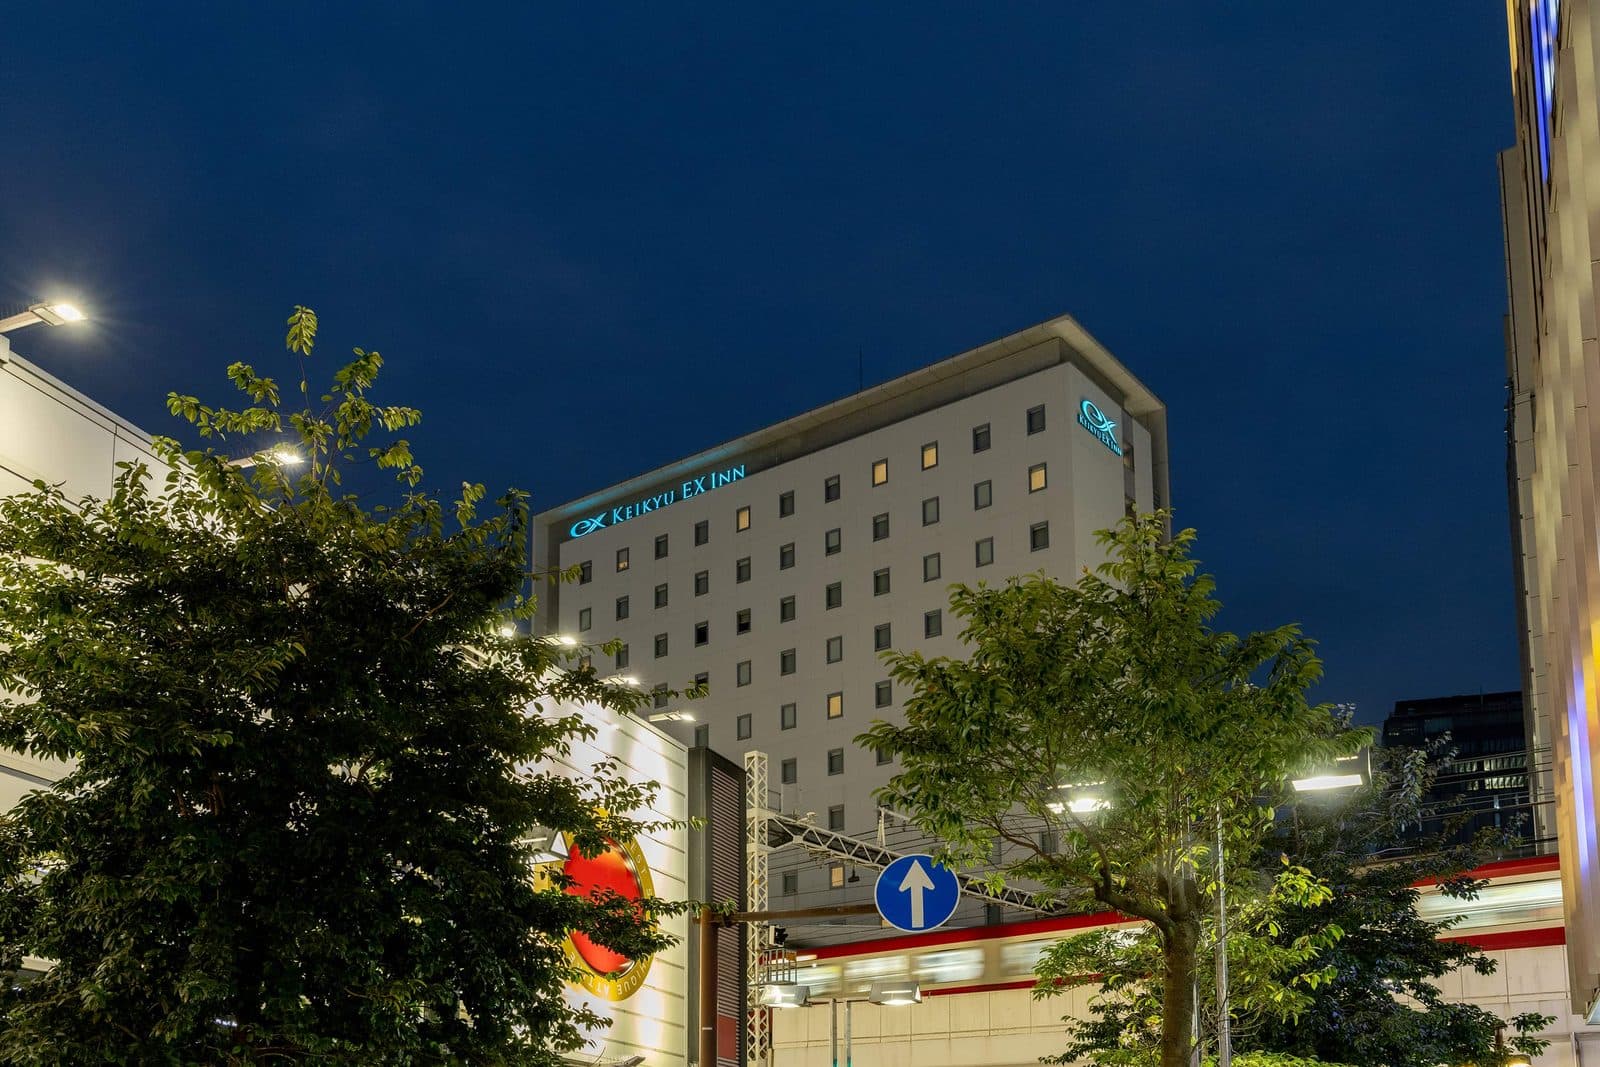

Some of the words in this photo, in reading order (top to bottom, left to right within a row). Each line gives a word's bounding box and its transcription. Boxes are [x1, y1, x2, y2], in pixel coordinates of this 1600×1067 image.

[611, 490, 675, 525] KEIKYU
[681, 475, 707, 500] EX
[711, 464, 746, 489] INN
